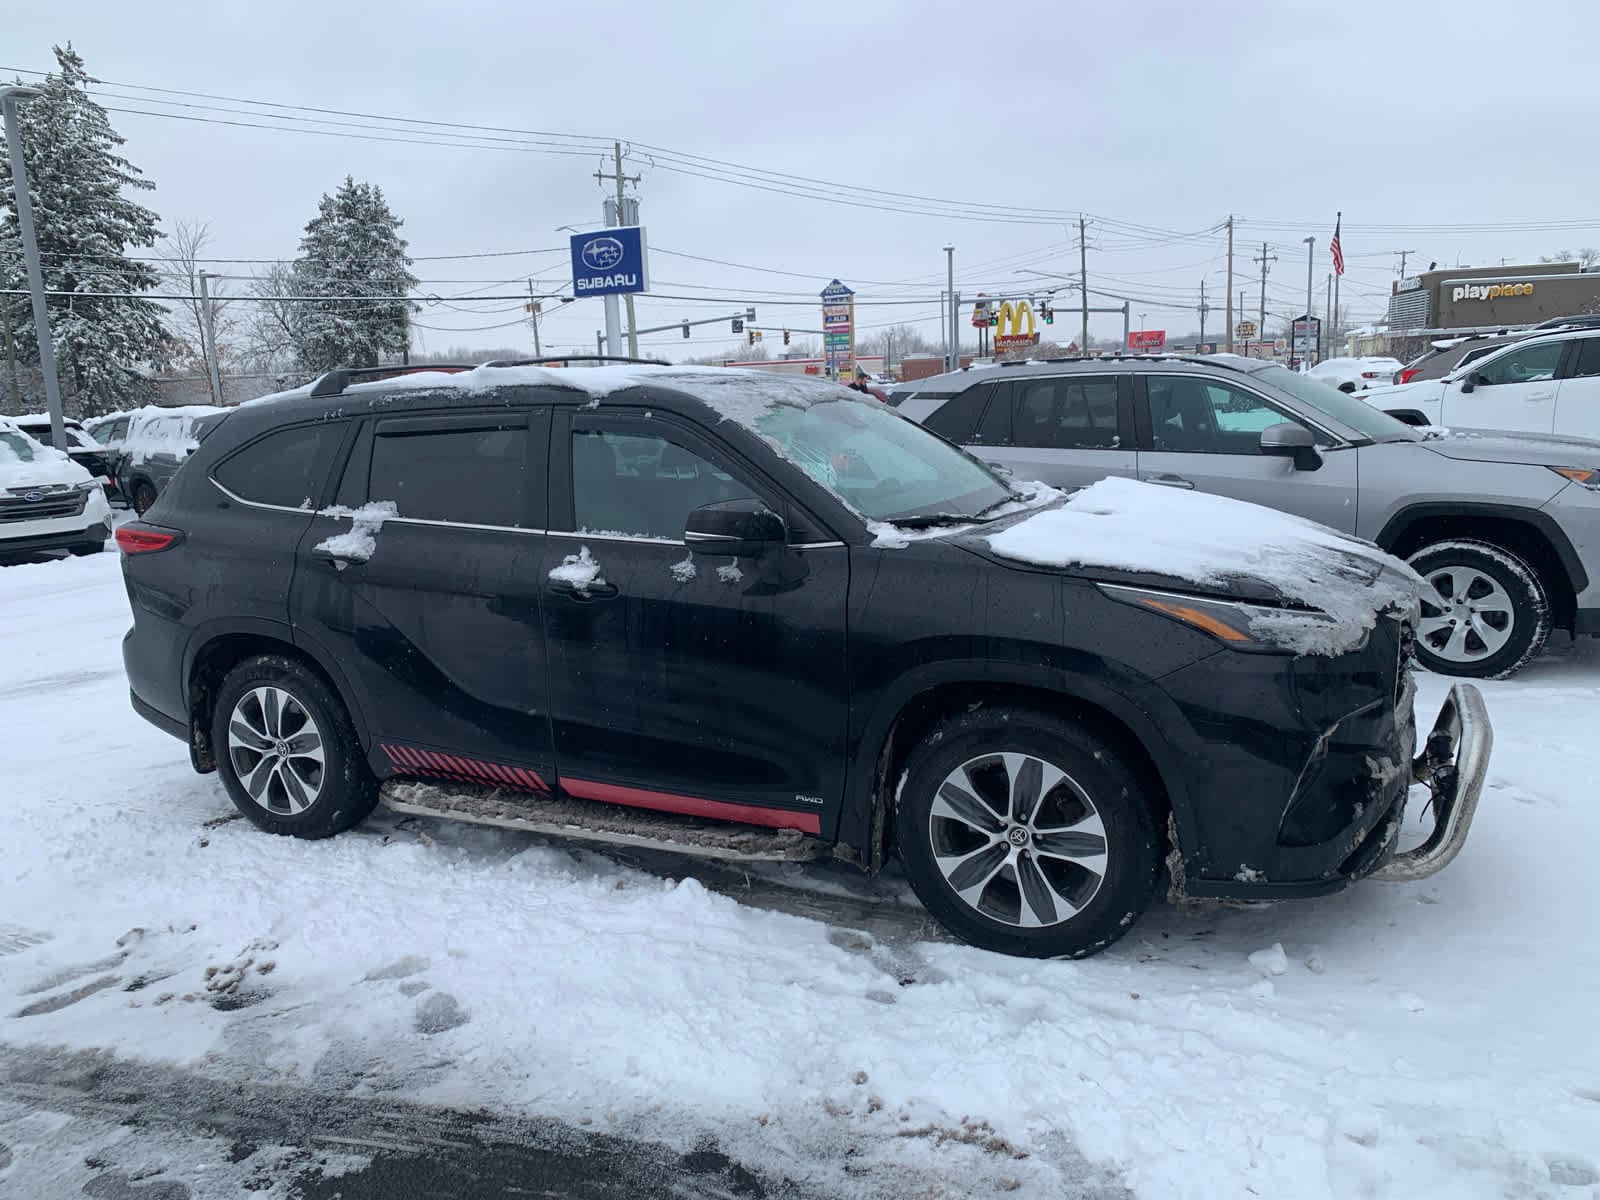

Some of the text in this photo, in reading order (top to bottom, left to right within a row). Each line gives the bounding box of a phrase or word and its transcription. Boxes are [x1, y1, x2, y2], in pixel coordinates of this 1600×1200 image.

[577, 273, 636, 290] SUBARU
[1452, 283, 1534, 302] playplace
[795, 794, 824, 804] AWD
